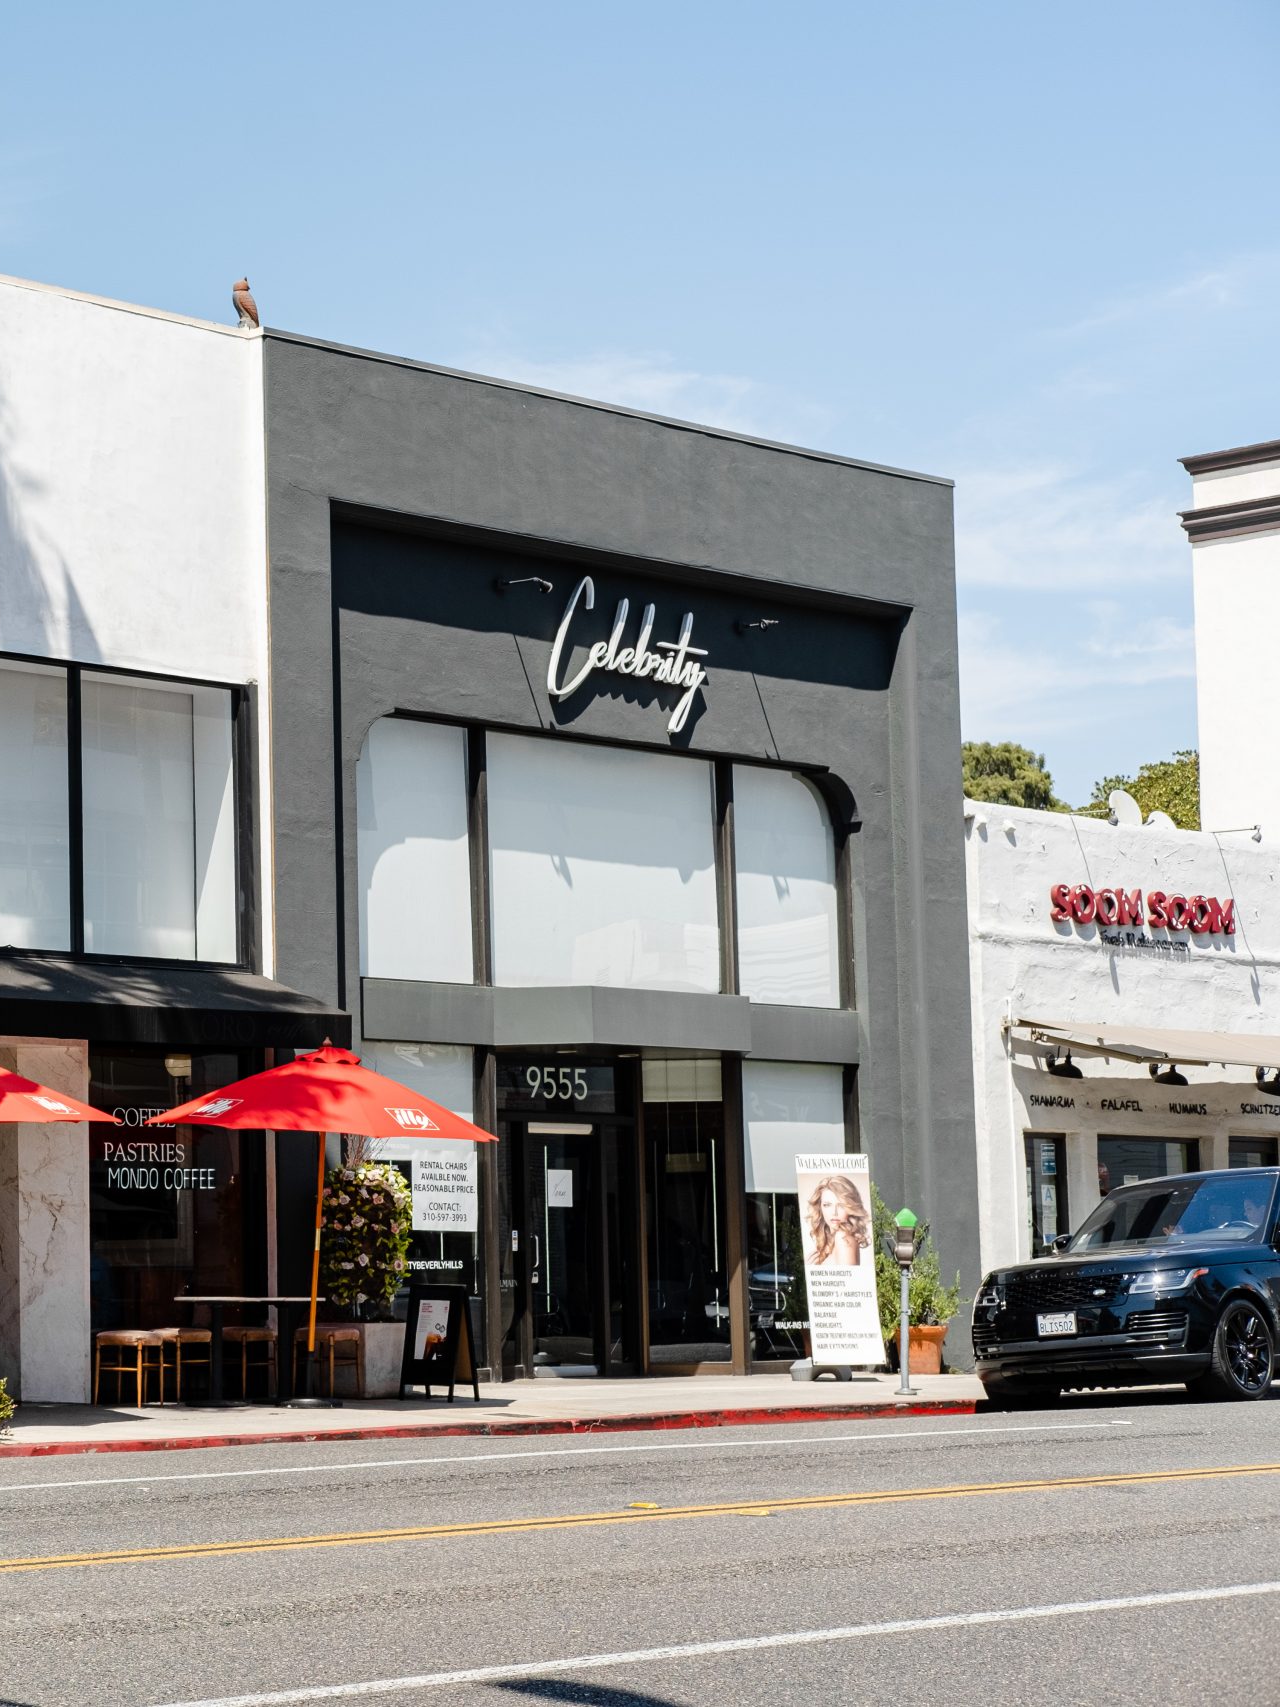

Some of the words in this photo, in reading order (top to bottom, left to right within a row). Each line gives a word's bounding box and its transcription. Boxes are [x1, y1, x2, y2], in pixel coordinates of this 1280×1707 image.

[547, 576, 708, 733] Celebrity
[1050, 884, 1144, 926] SOOM
[1147, 891, 1236, 935] SOOM
[526, 1066, 588, 1100] 9555
[1029, 1094, 1076, 1109] SHAWARMA
[1100, 1099, 1143, 1112] FALAFEL
[1169, 1102, 1207, 1115] HUMMUS
[1240, 1103, 1280, 1116] SCHNITZE
[103, 1142, 185, 1163] PASTRIES
[420, 1161, 443, 1170] RENTAL
[445, 1162, 468, 1171] CHAIRS
[108, 1167, 159, 1190] MONDO
[164, 1168, 216, 1190] COFFEE
[421, 1173, 450, 1181] AVAILBLE
[452, 1174, 468, 1182] NOW.
[414, 1184, 455, 1193] REASONABLE
[457, 1185, 476, 1194] PRICE.
[428, 1202, 461, 1211] CONTACT:
[422, 1213, 467, 1222] 310-597-3993
[407, 1260, 464, 1270] TYBEVERLYHILLS
[774, 1321, 802, 1330] WALK-INS
